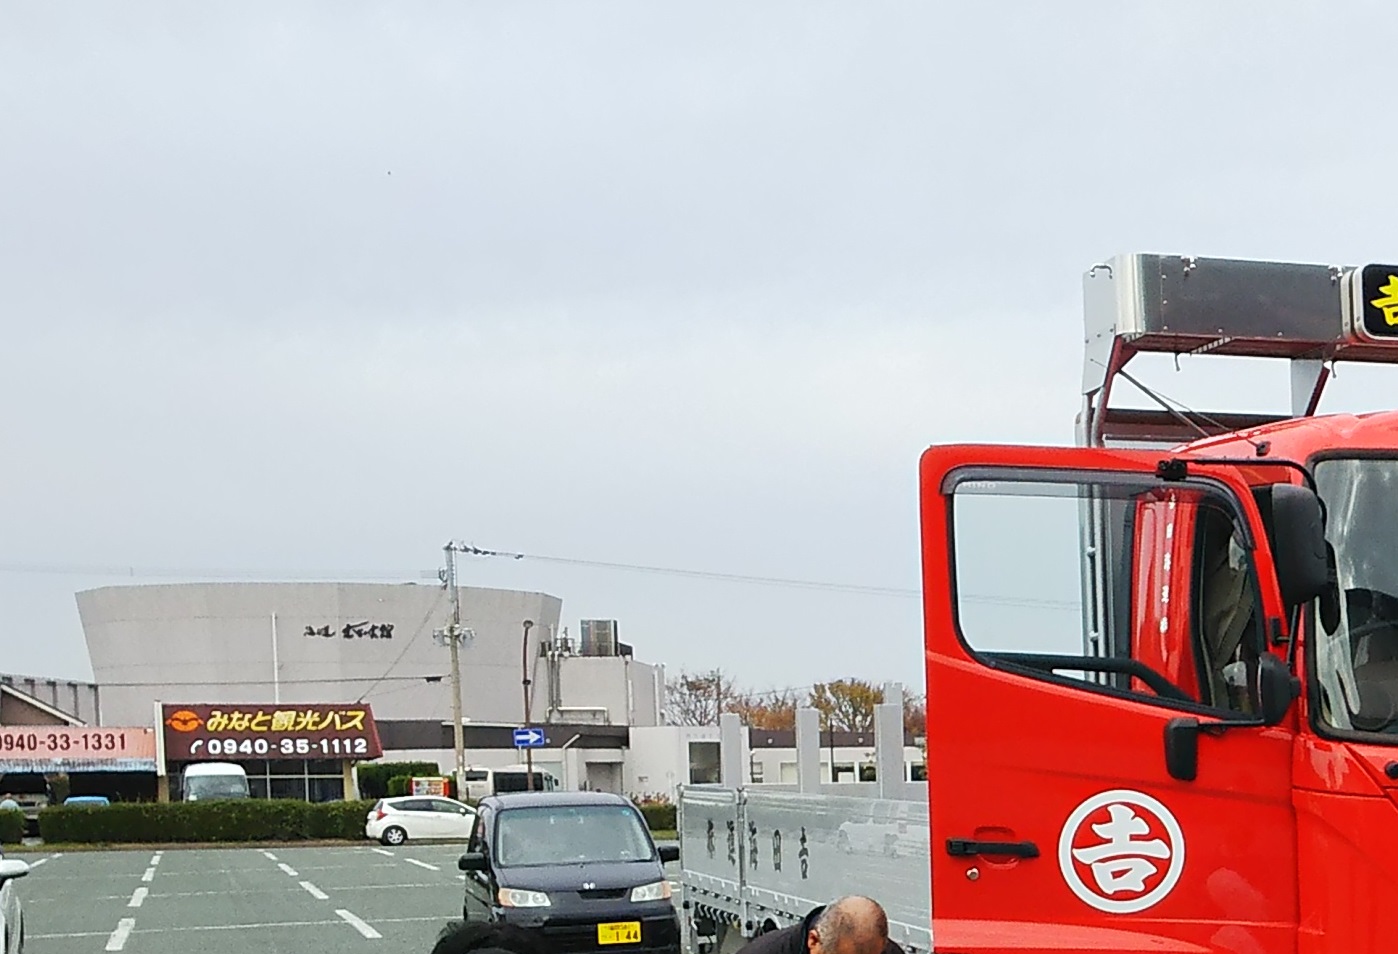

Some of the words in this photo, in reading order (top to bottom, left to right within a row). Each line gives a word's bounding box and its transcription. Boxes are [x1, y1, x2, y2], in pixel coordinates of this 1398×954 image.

[206, 710, 366, 732] みなと観光バス
[0, 733, 126, 751] 940-33-1331
[207, 738, 368, 755] 0940-35-1112
